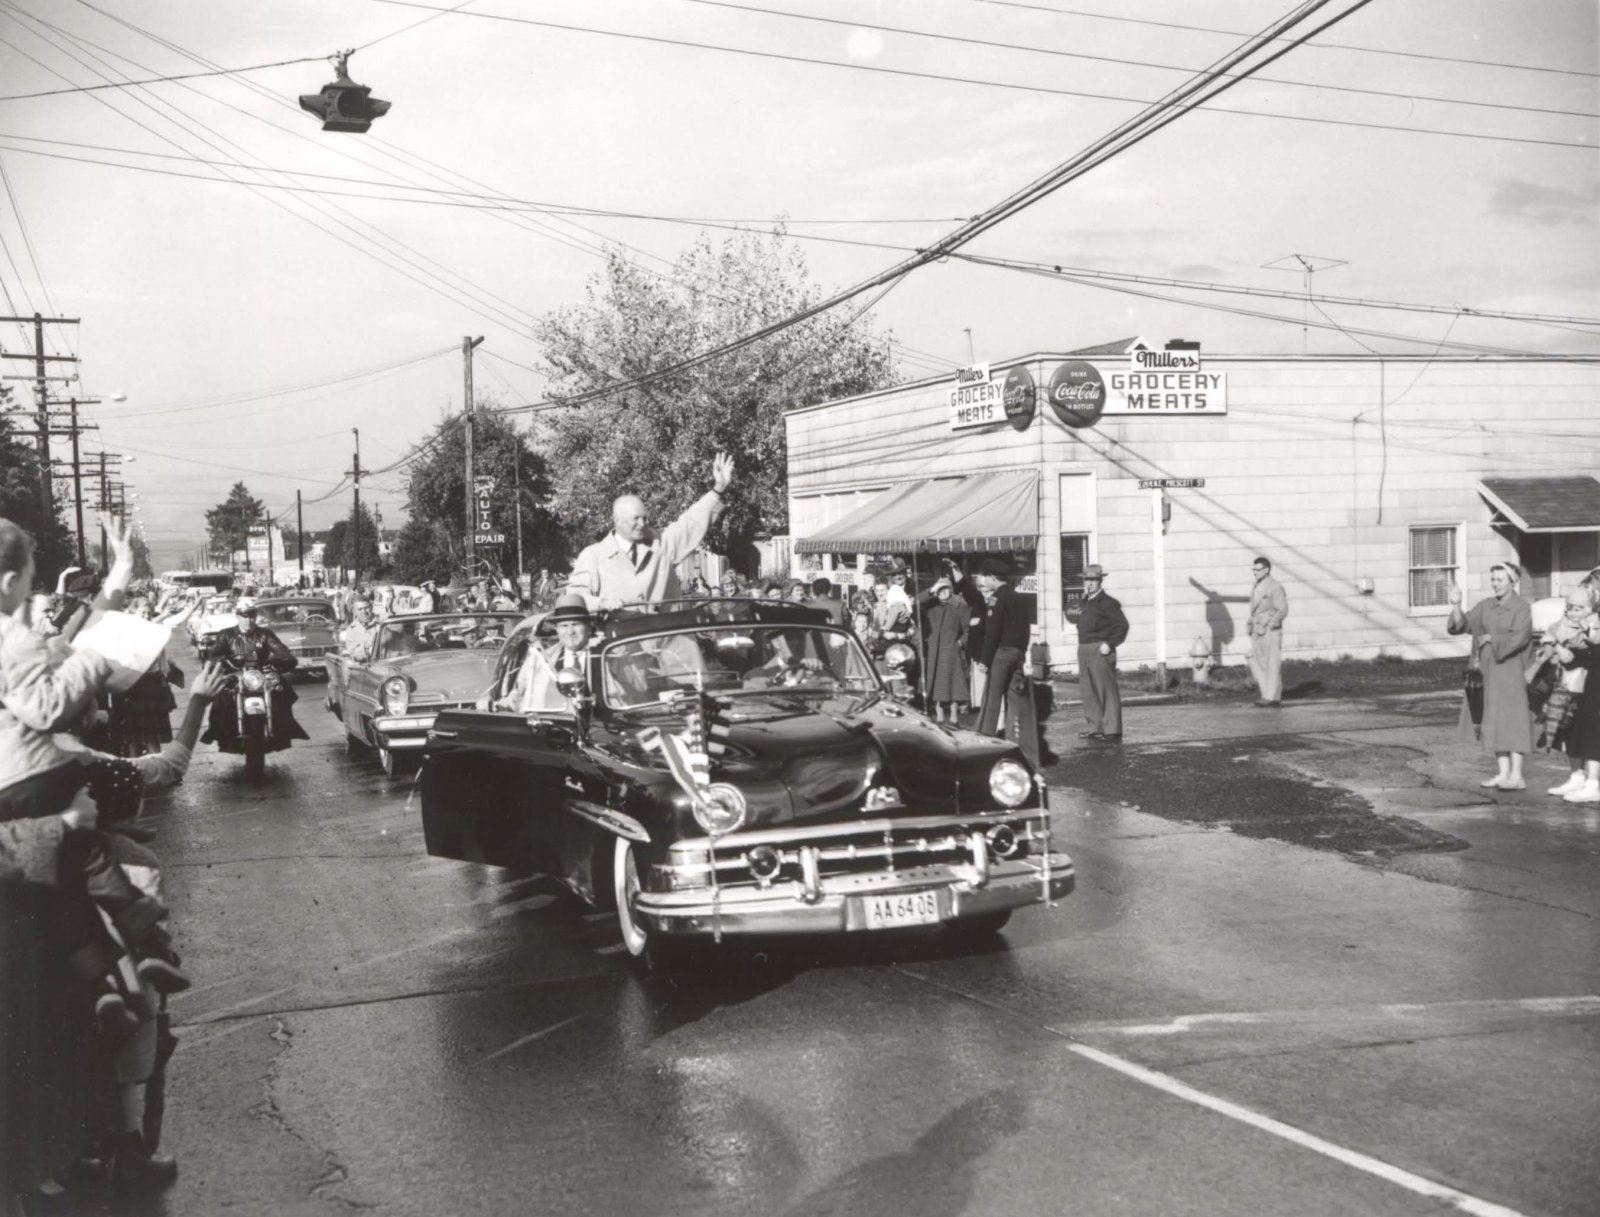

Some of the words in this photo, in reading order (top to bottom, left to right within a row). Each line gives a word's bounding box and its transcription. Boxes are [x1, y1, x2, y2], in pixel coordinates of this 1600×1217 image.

[1136, 351, 1198, 368] Millers
[1111, 374, 1221, 390] GROCERY
[951, 384, 1002, 407] GROCERY
[1127, 393, 1207, 409] MEATS
[958, 404, 993, 423] MEATS
[480, 489, 491, 530] AUTO
